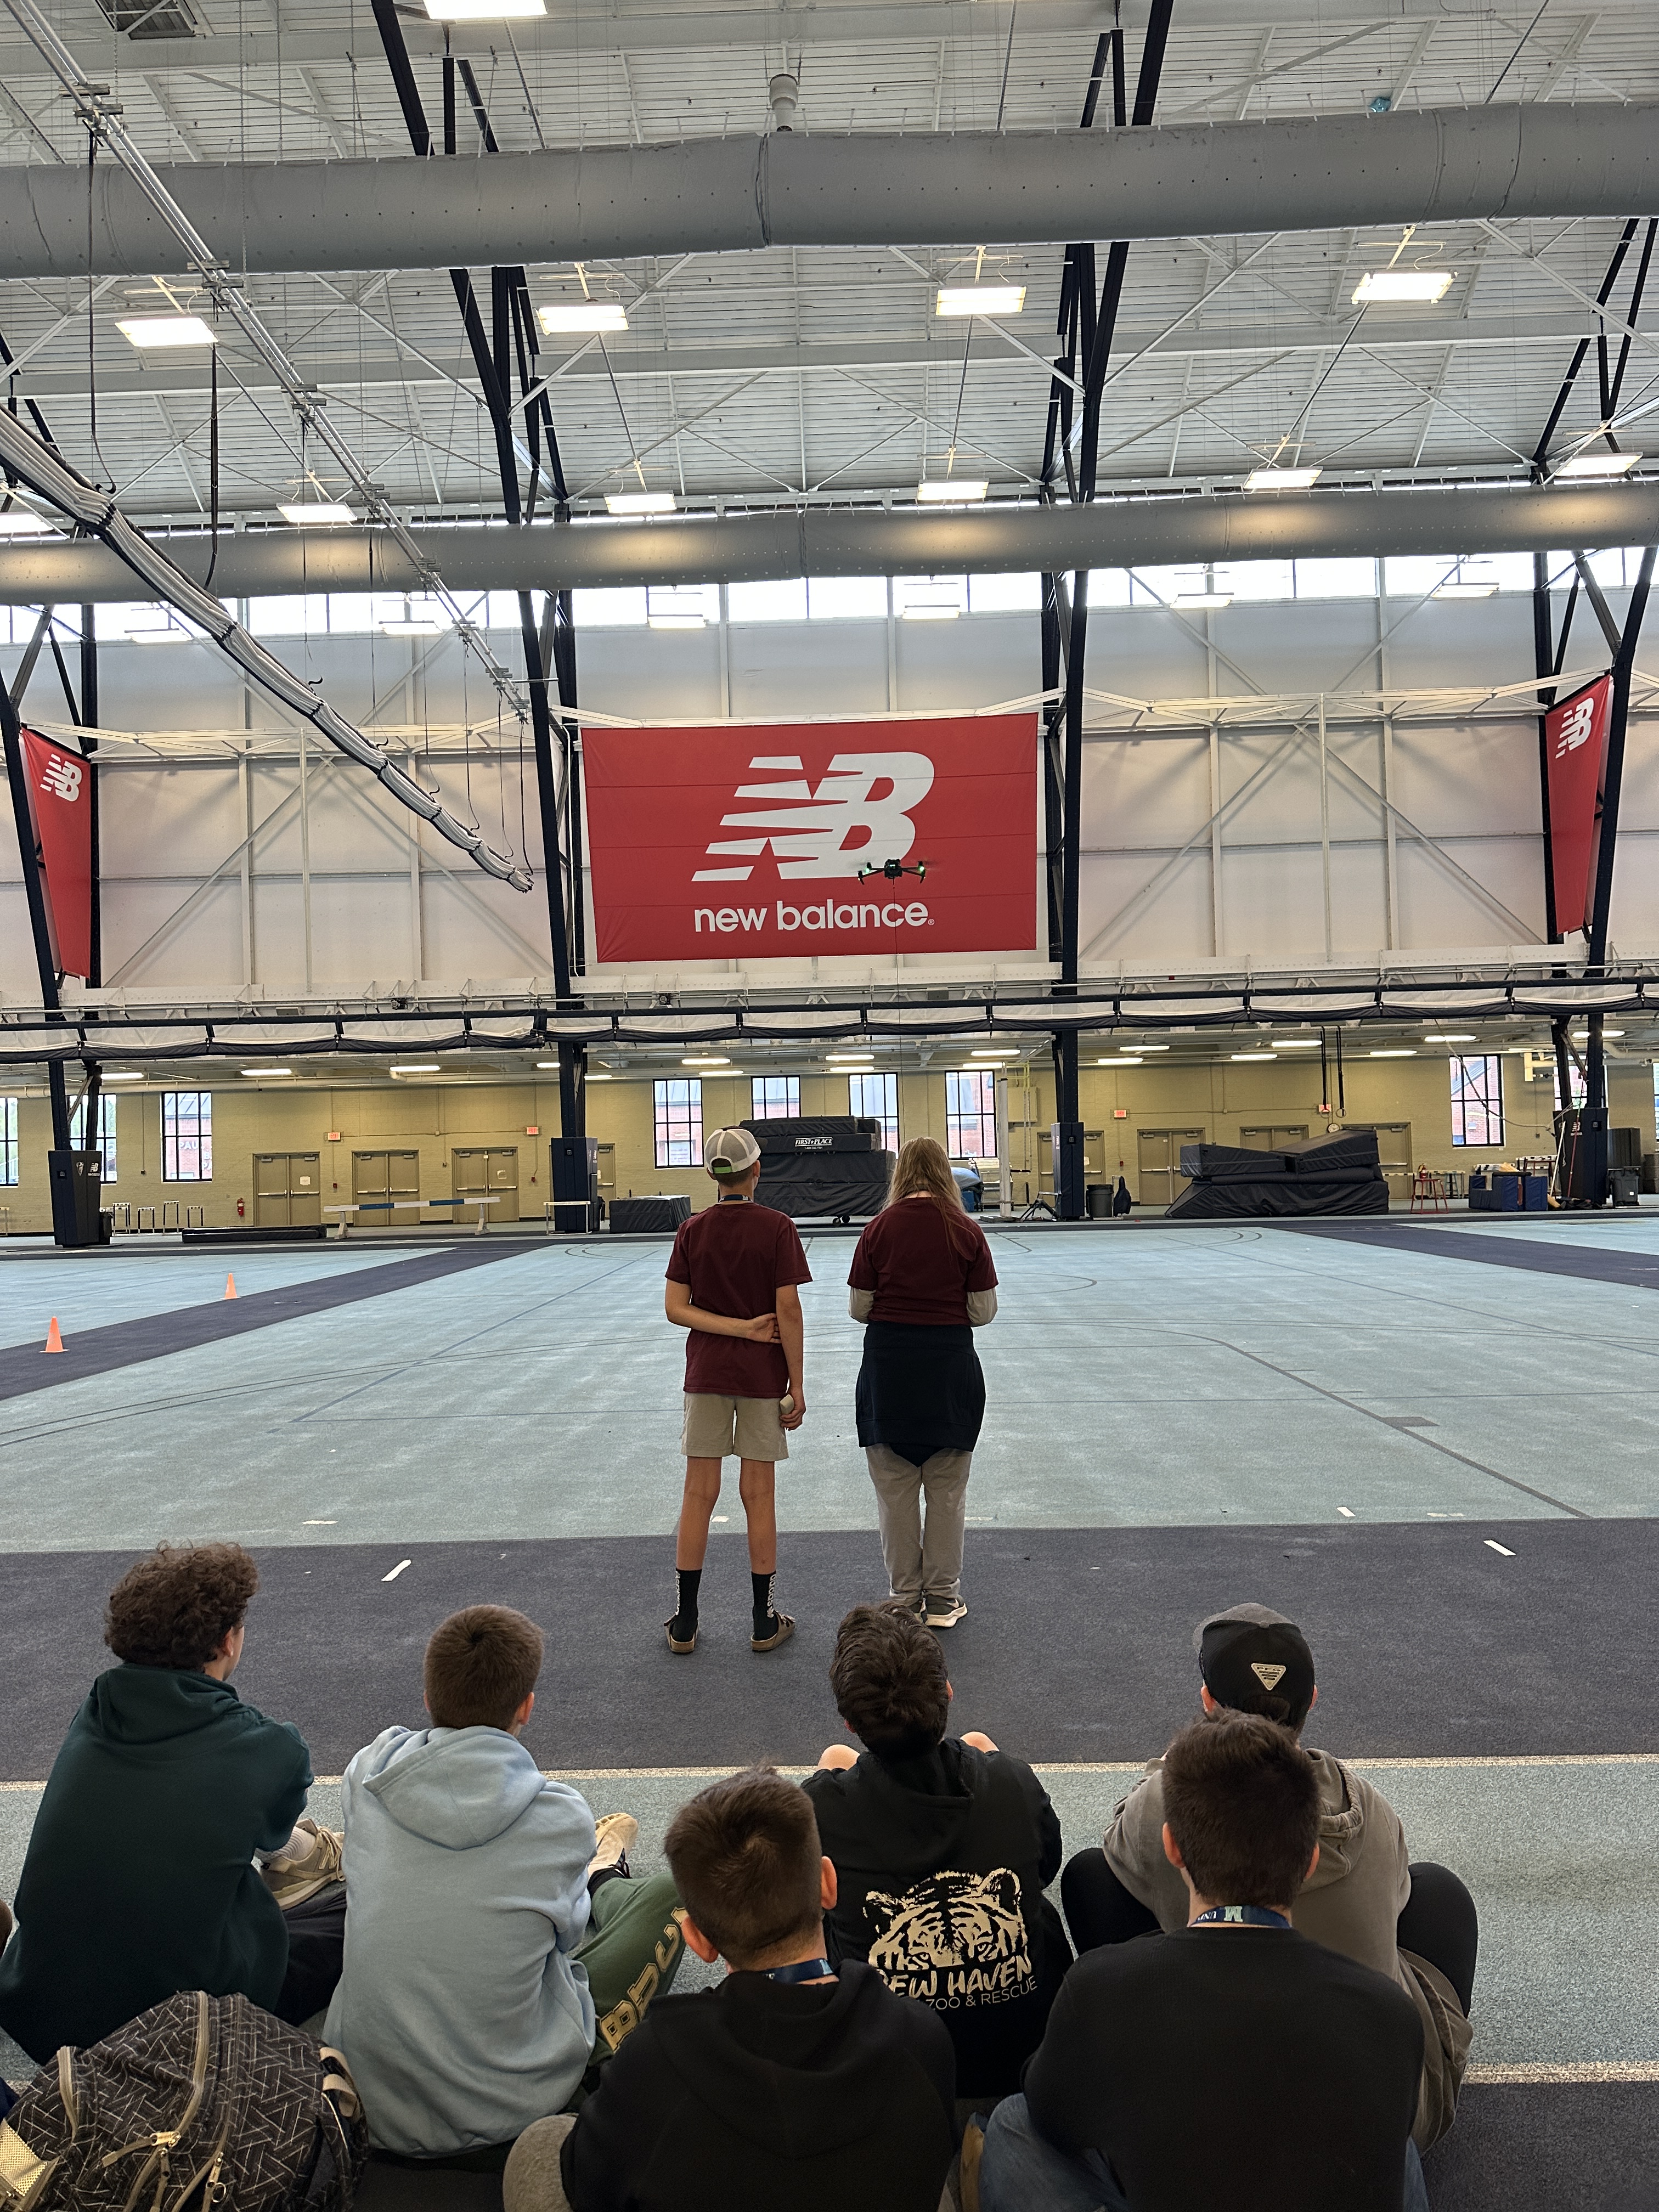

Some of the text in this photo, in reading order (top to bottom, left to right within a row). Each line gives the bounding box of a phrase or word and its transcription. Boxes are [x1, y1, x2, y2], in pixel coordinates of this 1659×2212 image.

[694, 906, 768, 932] new
[1223, 1905, 1243, 1922] M
[876, 1945, 1032, 1999] EW HAVEN
[966, 1994, 977, 2007] &
[981, 1975, 1039, 2005] RESCUE
